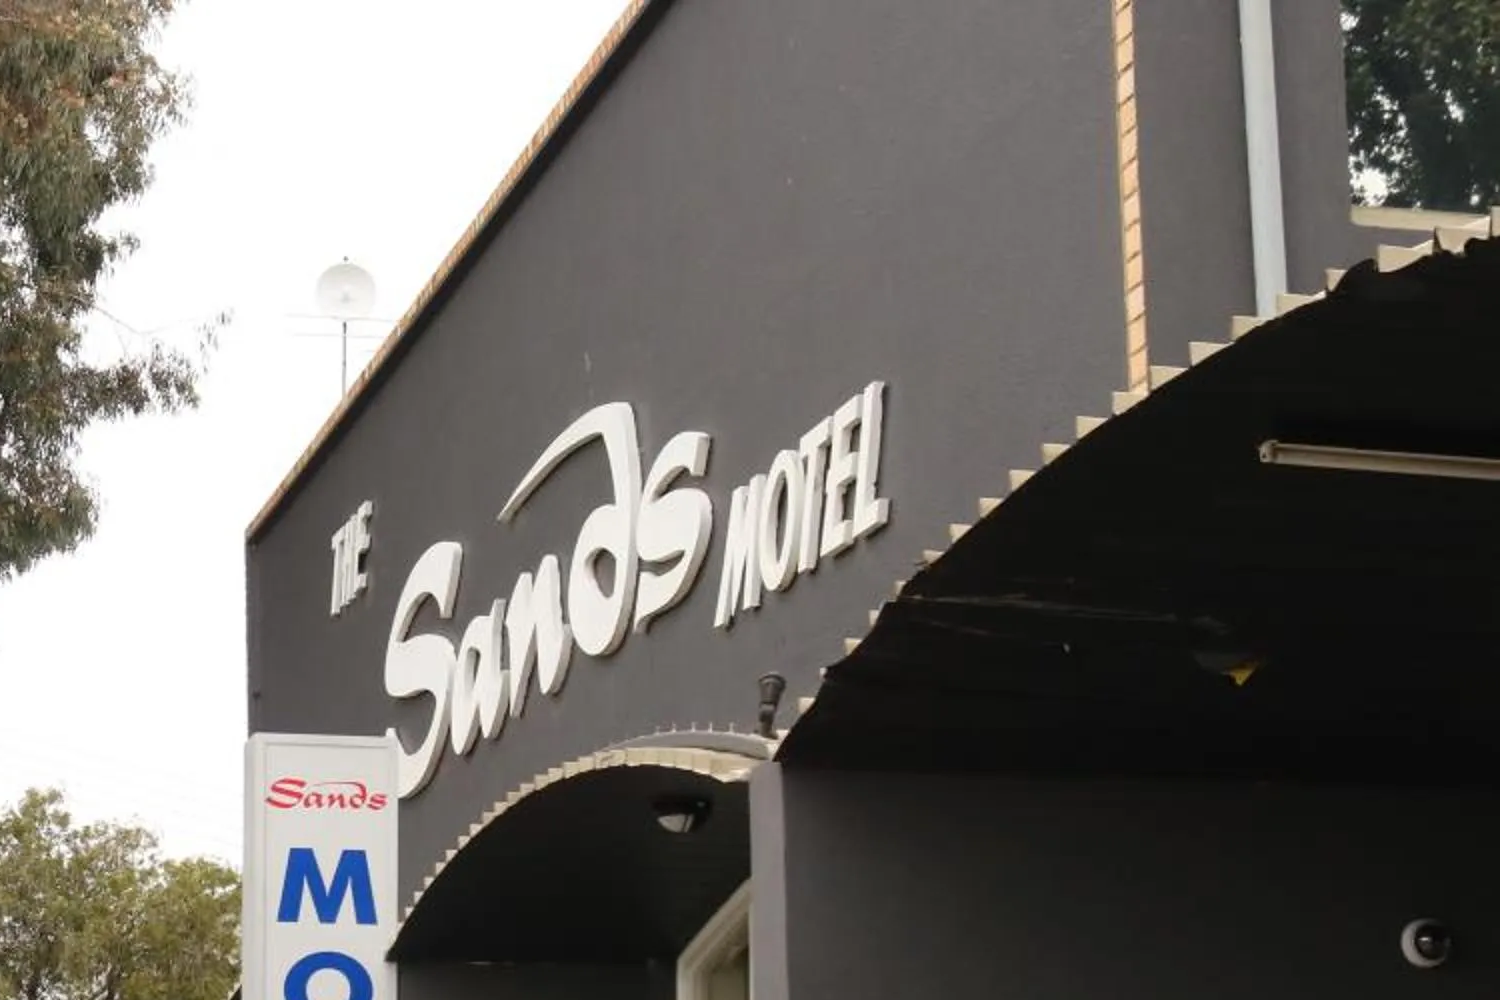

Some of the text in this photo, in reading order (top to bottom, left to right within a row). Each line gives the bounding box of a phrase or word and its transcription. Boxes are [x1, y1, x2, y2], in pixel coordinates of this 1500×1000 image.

[330, 380, 892, 800] THE Sands MOTEL
[264, 777, 389, 812] Sands
